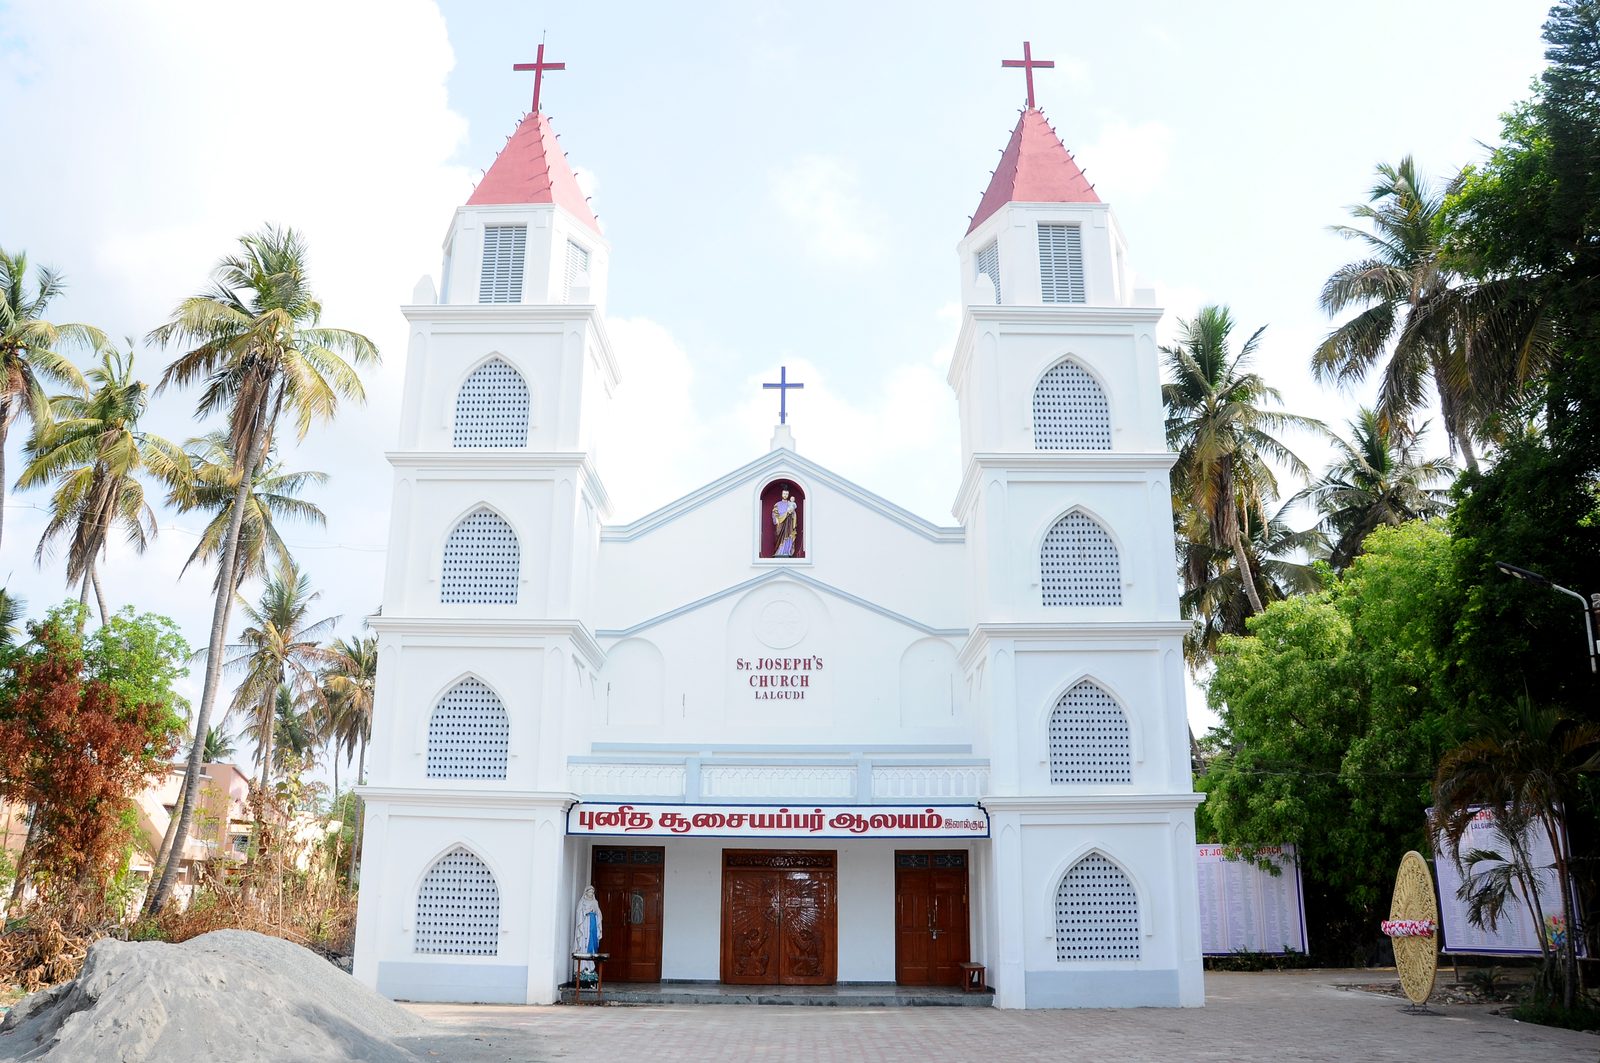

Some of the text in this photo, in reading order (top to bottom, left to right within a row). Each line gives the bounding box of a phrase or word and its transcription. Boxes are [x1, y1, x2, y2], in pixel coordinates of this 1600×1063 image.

[756, 654, 823, 671] JOSEPH'S
[749, 674, 810, 688] CHURCH
[755, 690, 805, 700] LALGUDI
[579, 805, 654, 832] புனித
[658, 808, 826, 833] சூசையப்பர்
